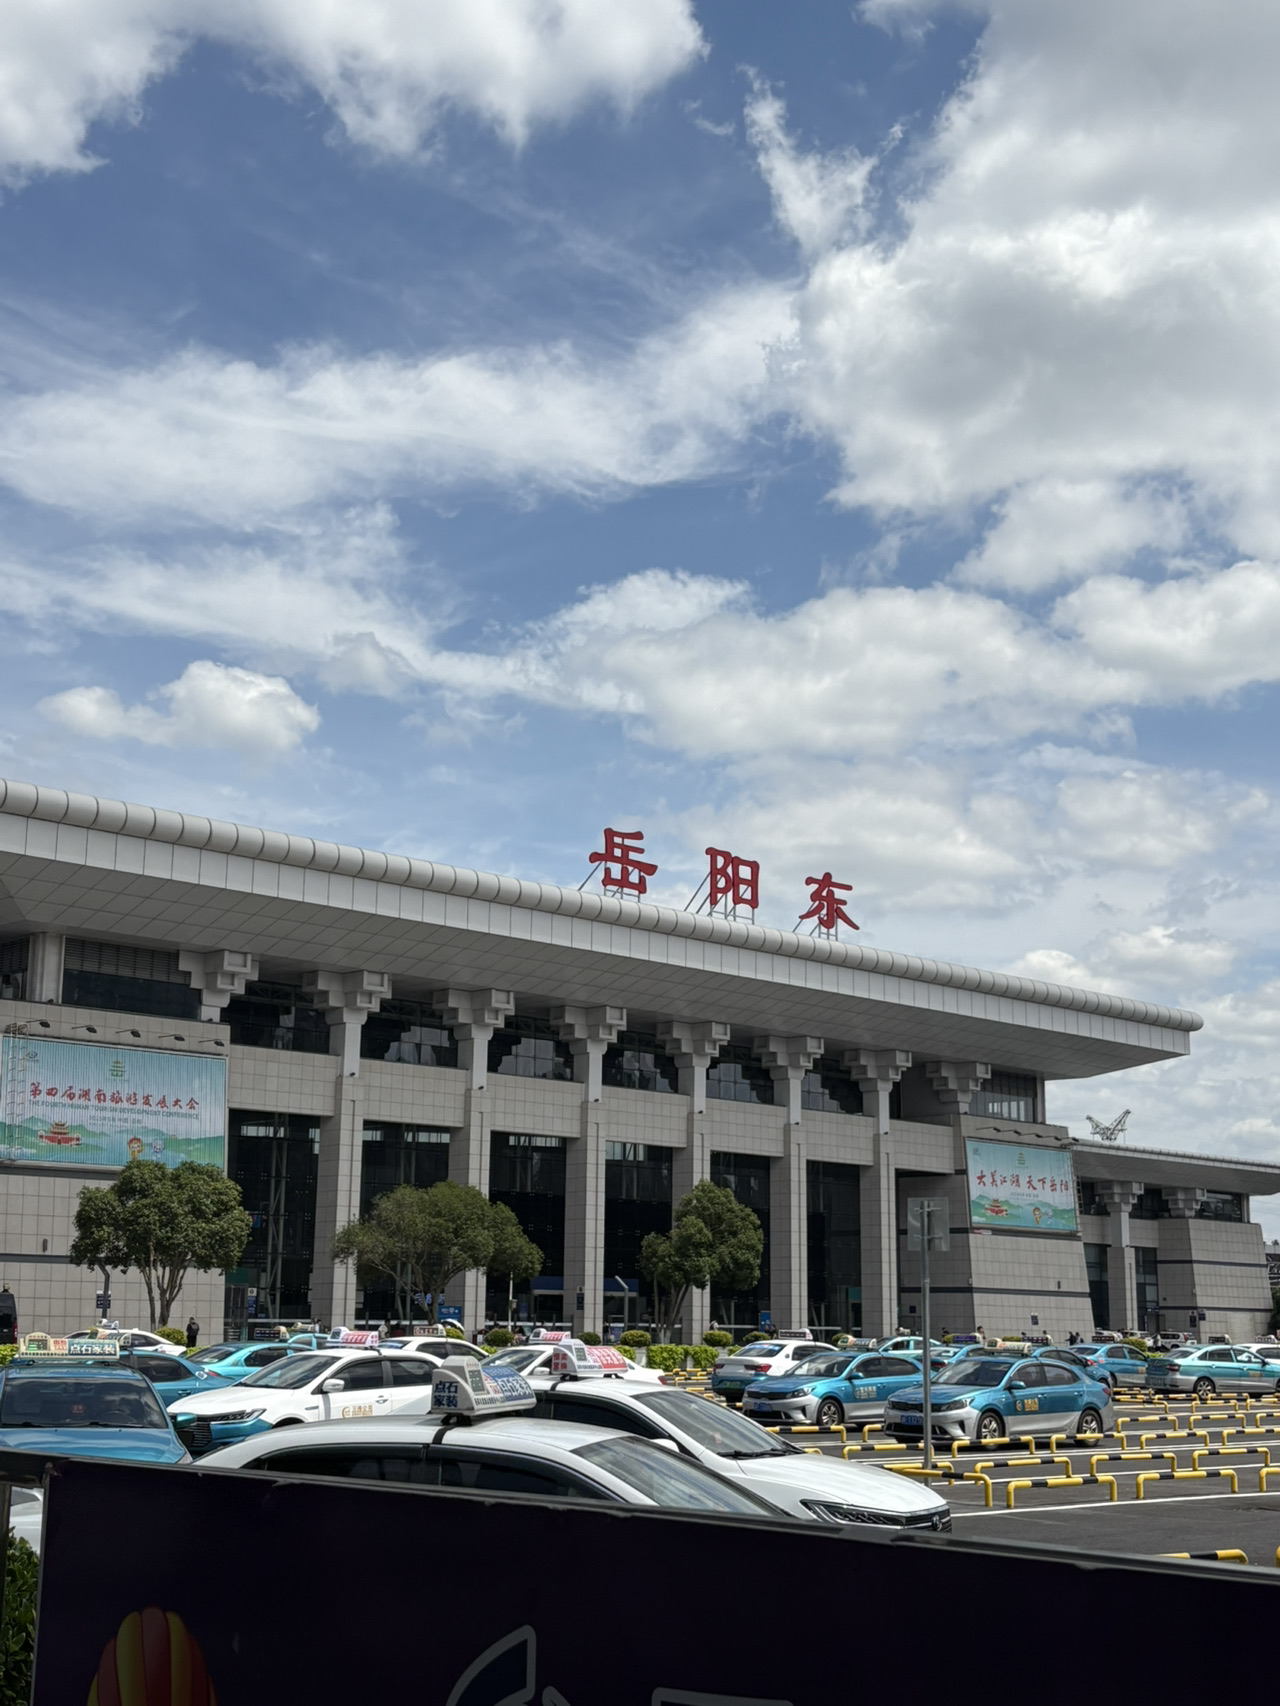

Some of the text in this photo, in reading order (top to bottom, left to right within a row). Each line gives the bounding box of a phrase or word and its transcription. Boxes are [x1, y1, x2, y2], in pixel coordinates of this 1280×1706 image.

[588, 827, 860, 930] 岳阳东
[30, 1081, 199, 1110] 第四届湖南旅游发展大会
[976, 1169, 1069, 1193] 大美江湖 天下岳阳
[70, 1344, 115, 1355] 点石家装
[434, 1381, 459, 1394] 点石
[433, 1395, 458, 1408] 家装
